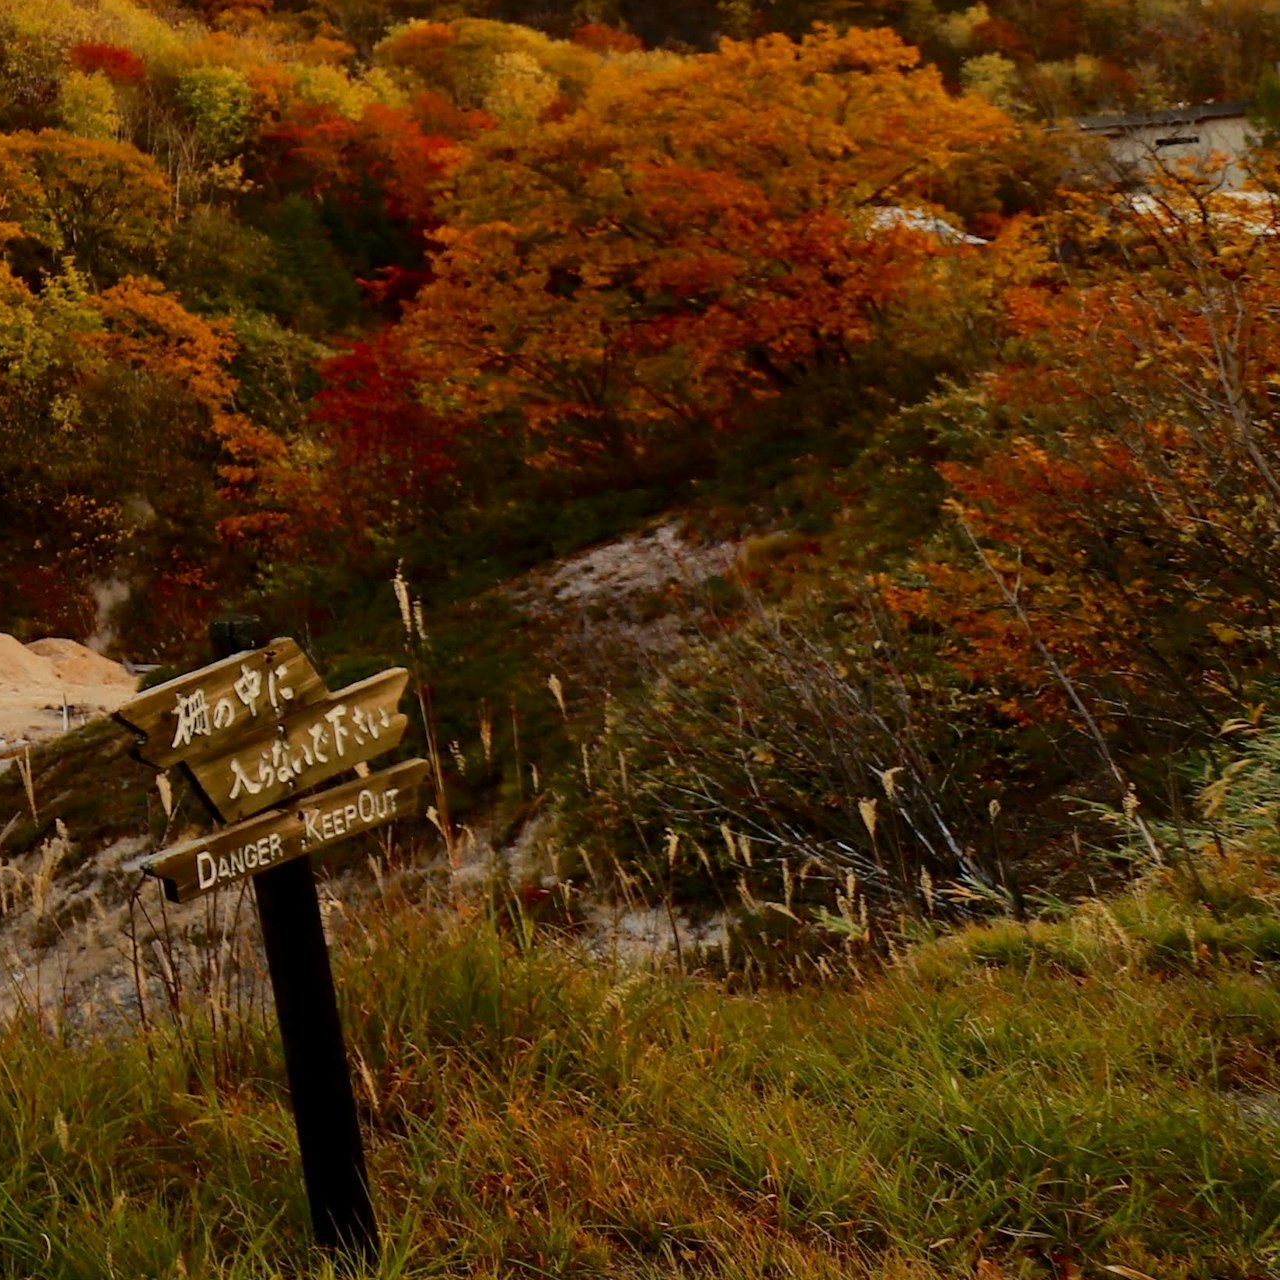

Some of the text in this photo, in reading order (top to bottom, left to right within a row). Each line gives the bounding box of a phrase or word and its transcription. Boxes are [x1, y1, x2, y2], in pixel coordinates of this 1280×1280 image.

[172, 664, 294, 748] 柵の中に
[230, 705, 390, 799] 入らないで下さい
[197, 833, 283, 890] DANGER
